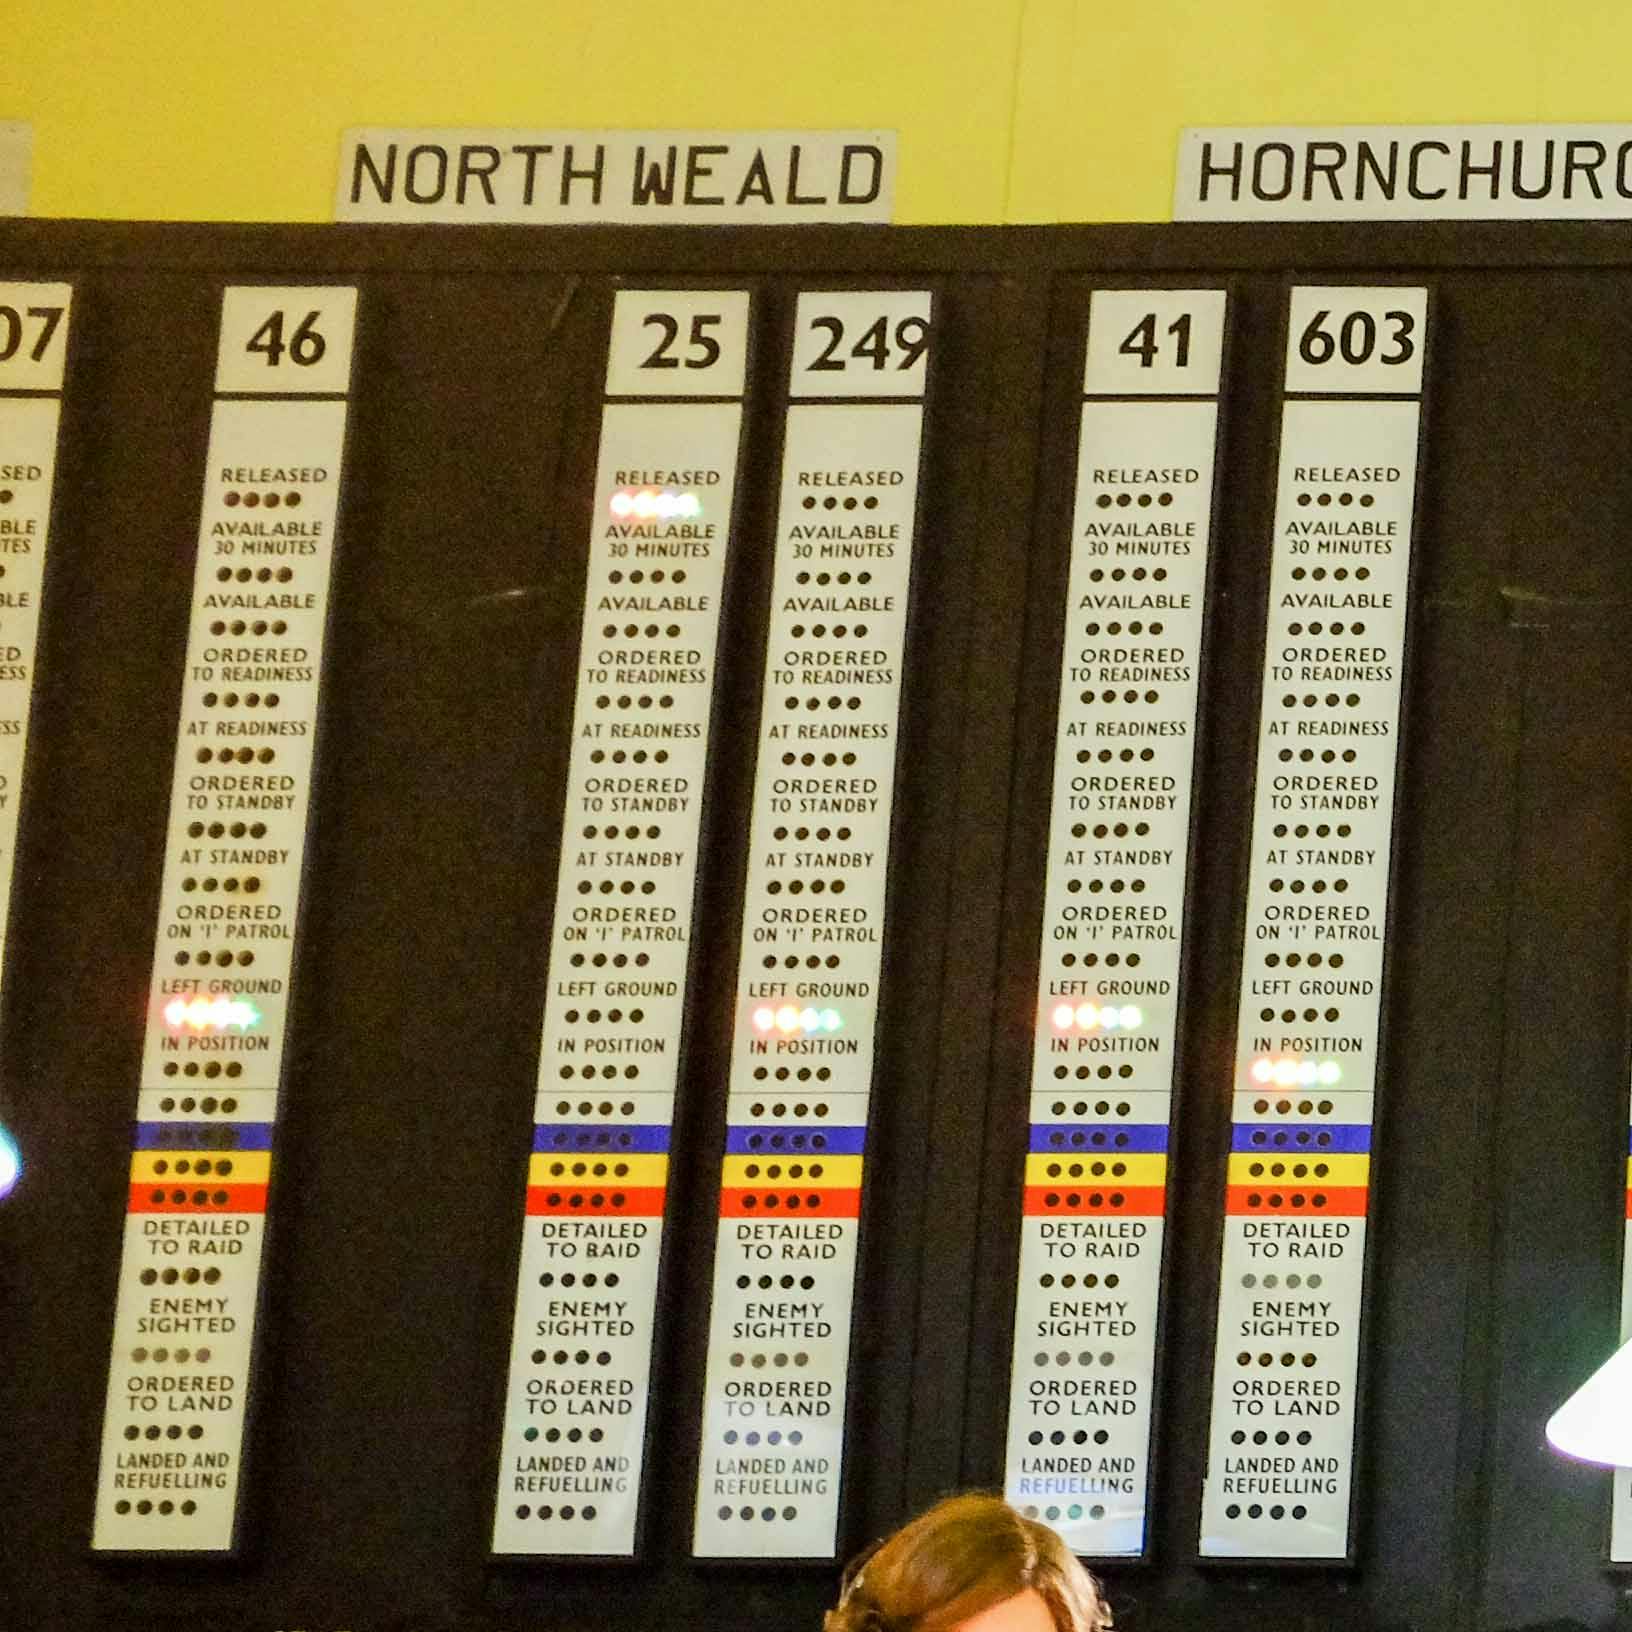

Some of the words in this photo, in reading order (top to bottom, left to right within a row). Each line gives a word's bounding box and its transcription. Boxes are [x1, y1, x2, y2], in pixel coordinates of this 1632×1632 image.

[351, 144, 604, 205] NORTH
[633, 145, 882, 205] WEALD
[246, 311, 325, 366] 46
[640, 314, 721, 369] 25
[807, 310, 934, 376] 249
[1119, 314, 1191, 367] 41
[1300, 311, 1414, 365] 603
[1252, 980, 1290, 995] LEFT
[1299, 981, 1373, 995] GROUND
[1254, 1038, 1271, 1051] IN
[1281, 1037, 1362, 1052] POSITION
[138, 1317, 235, 1333] SIGHTED
[150, 1298, 228, 1314] ENEMY
